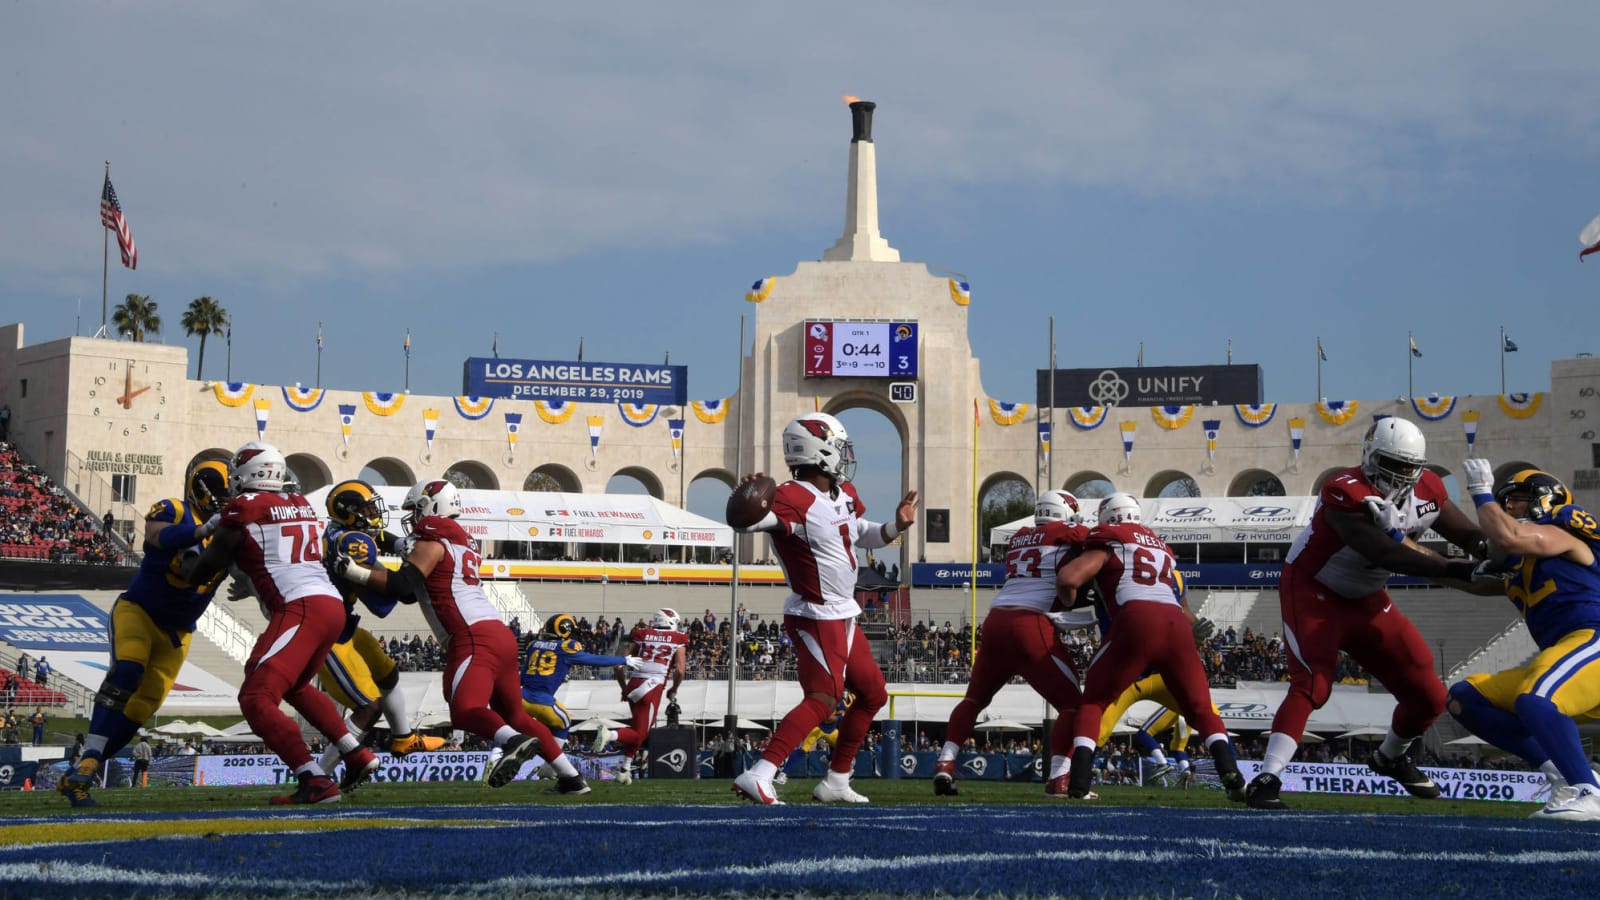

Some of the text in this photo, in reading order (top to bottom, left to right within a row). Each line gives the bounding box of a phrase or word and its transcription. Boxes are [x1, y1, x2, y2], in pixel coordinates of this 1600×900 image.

[842, 343, 881, 356] 0:44
[813, 355, 824, 369] 7
[898, 356, 909, 369] 3
[485, 363, 672, 384] LOS ANGELES RAMS
[94, 376, 106, 386] 10
[1138, 376, 1204, 394] UNIFY
[90, 390, 96, 399] 9
[513, 385, 644, 400] DECEMBER 29, 2019
[893, 386, 912, 400] 40
[107, 422, 113, 431] 7
[123, 428, 130, 436] 6
[140, 424, 148, 433] 5
[87, 450, 163, 465] JULIA & GEORGE
[85, 462, 163, 475] ARGYROS PLAZA
[270, 505, 316, 520] HUMPHRIE
[598, 512, 646, 520] REWARDS
[1570, 509, 1598, 535] 52
[564, 528, 577, 537] FUEL
[578, 528, 604, 538] REWARDS
[678, 532, 690, 540] FUEL
[690, 532, 716, 541] REWARDS
[281, 524, 322, 564] 74
[1011, 532, 1045, 548] SHIPLEY
[838, 524, 857, 572] 1
[1006, 548, 1042, 578] 53
[1132, 547, 1176, 586] 64
[952, 570, 992, 578] HYUDAI
[644, 634, 672, 642] ARNOLD
[224, 758, 286, 767] 2020 SEA
[420, 755, 434, 764] AT
[437, 754, 464, 764] $105
[467, 754, 489, 763] PER
[1286, 765, 1379, 776] SEASON TICKE
[1452, 772, 1467, 781] AT
[1469, 772, 1498, 782] $105
[1501, 774, 1524, 783] PER
[1527, 775, 1546, 785] GA
[1302, 776, 1514, 799] THERAMS.M/2020
